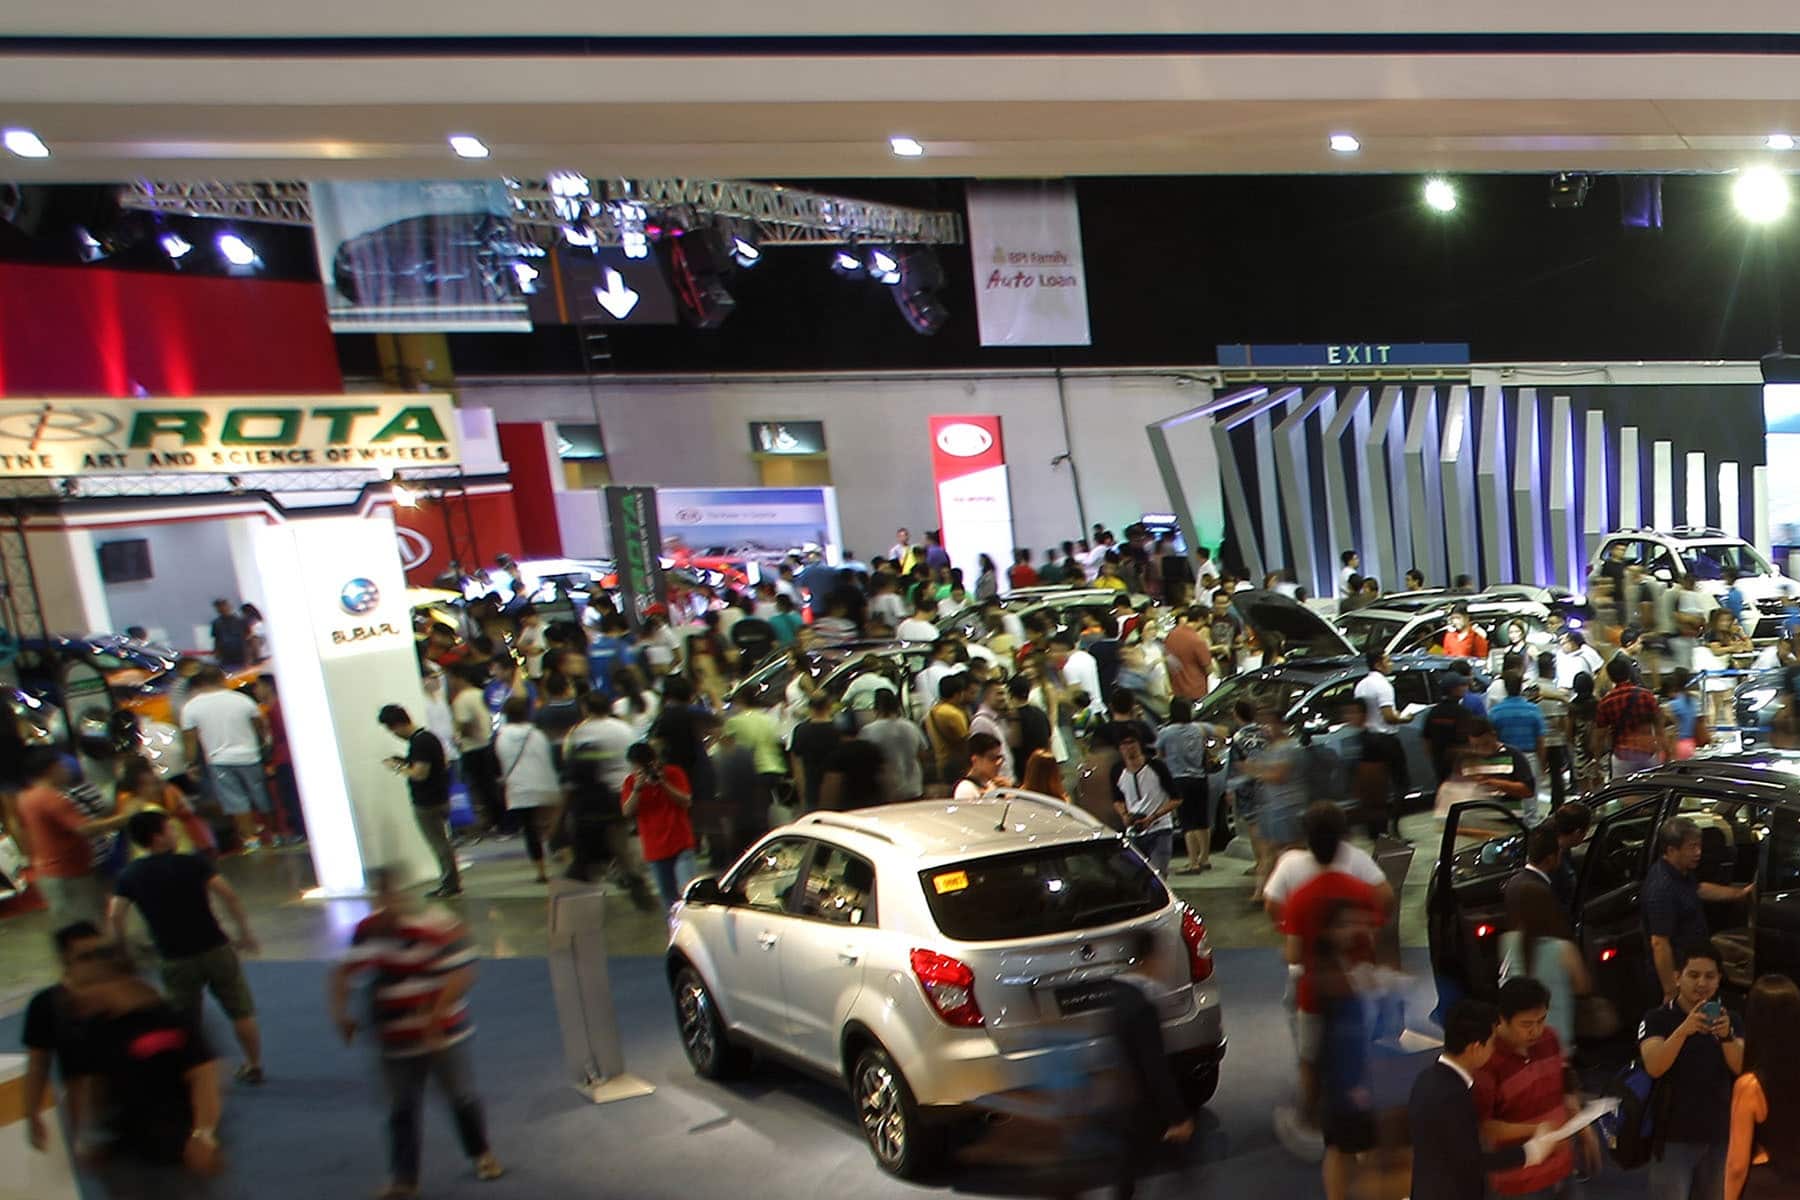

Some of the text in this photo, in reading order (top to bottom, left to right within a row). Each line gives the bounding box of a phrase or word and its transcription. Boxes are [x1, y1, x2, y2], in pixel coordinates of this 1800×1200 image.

[986, 269, 1076, 289] Auto Loan
[1327, 345, 1391, 364] EXIT
[128, 406, 447, 448] ROTA
[0, 453, 53, 469] THE
[82, 453, 128, 469] ART
[149, 451, 196, 467] AND
[211, 449, 314, 465] SCIENCE
[326, 448, 350, 463] OF
